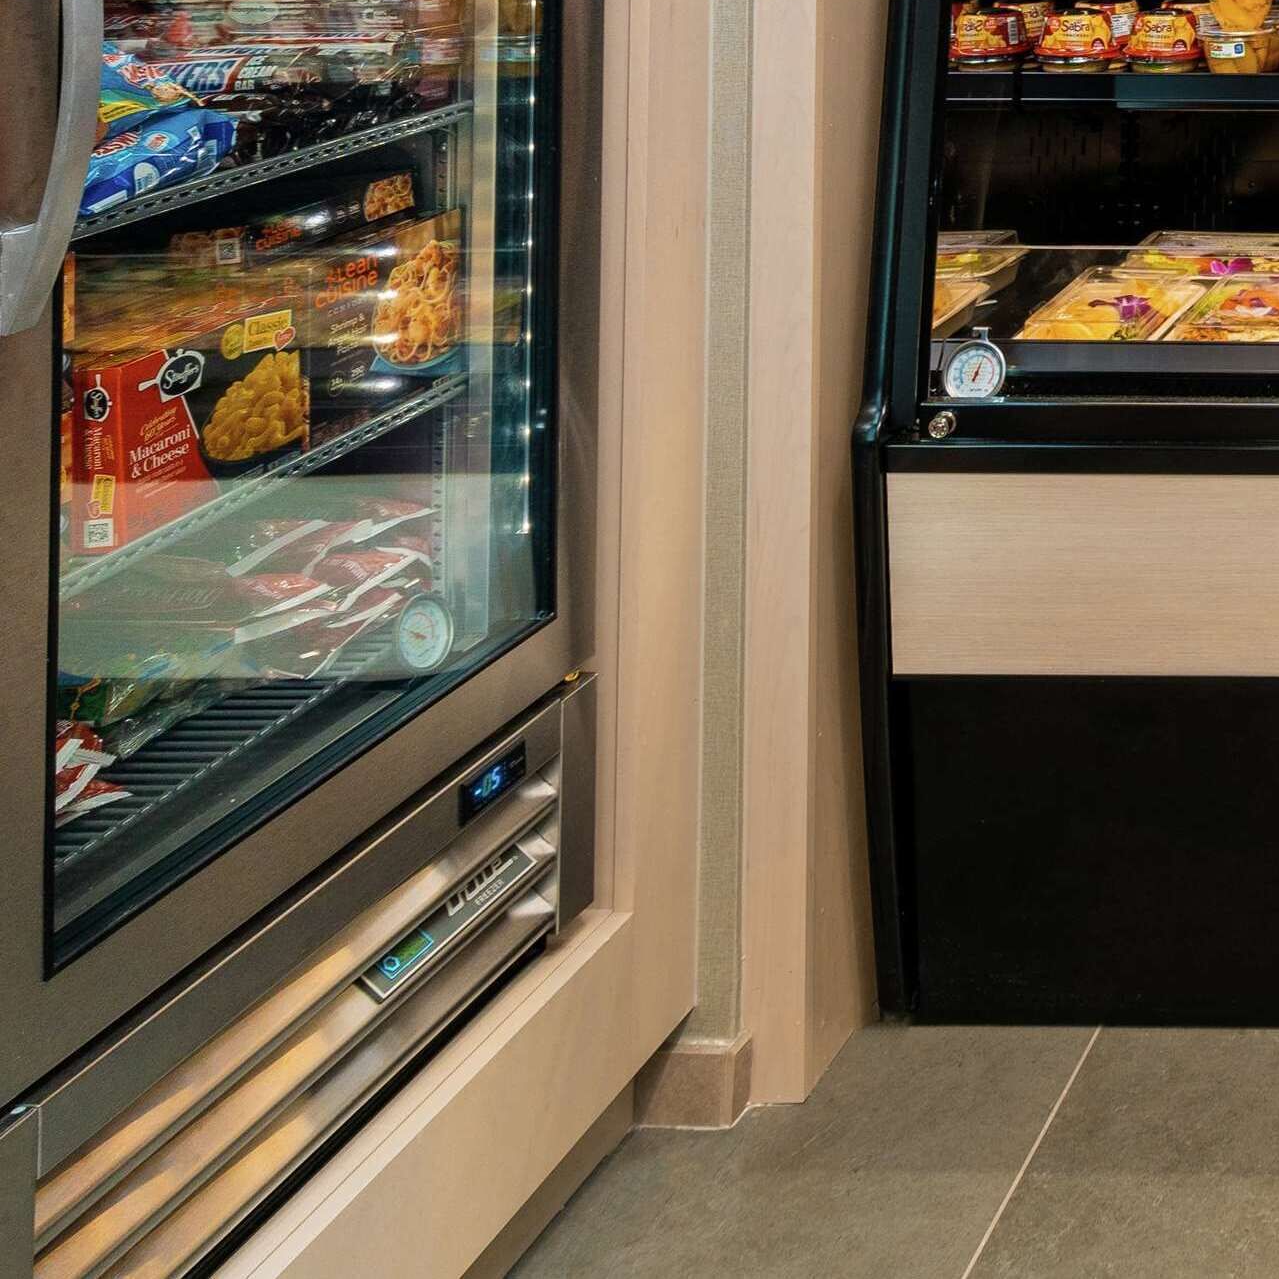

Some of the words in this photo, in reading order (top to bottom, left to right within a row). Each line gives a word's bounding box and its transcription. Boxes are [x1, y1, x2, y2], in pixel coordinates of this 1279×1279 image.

[1062, 20, 1090, 32] Sabra
[1144, 21, 1173, 33] Sabra
[238, 66, 278, 79] CREAM
[234, 80, 255, 91] BAR
[339, 255, 379, 283] Lean
[315, 271, 379, 309] Cuisine
[128, 424, 192, 466] Macaroni
[131, 463, 142, 479] &
[143, 443, 190, 473] Cheese
